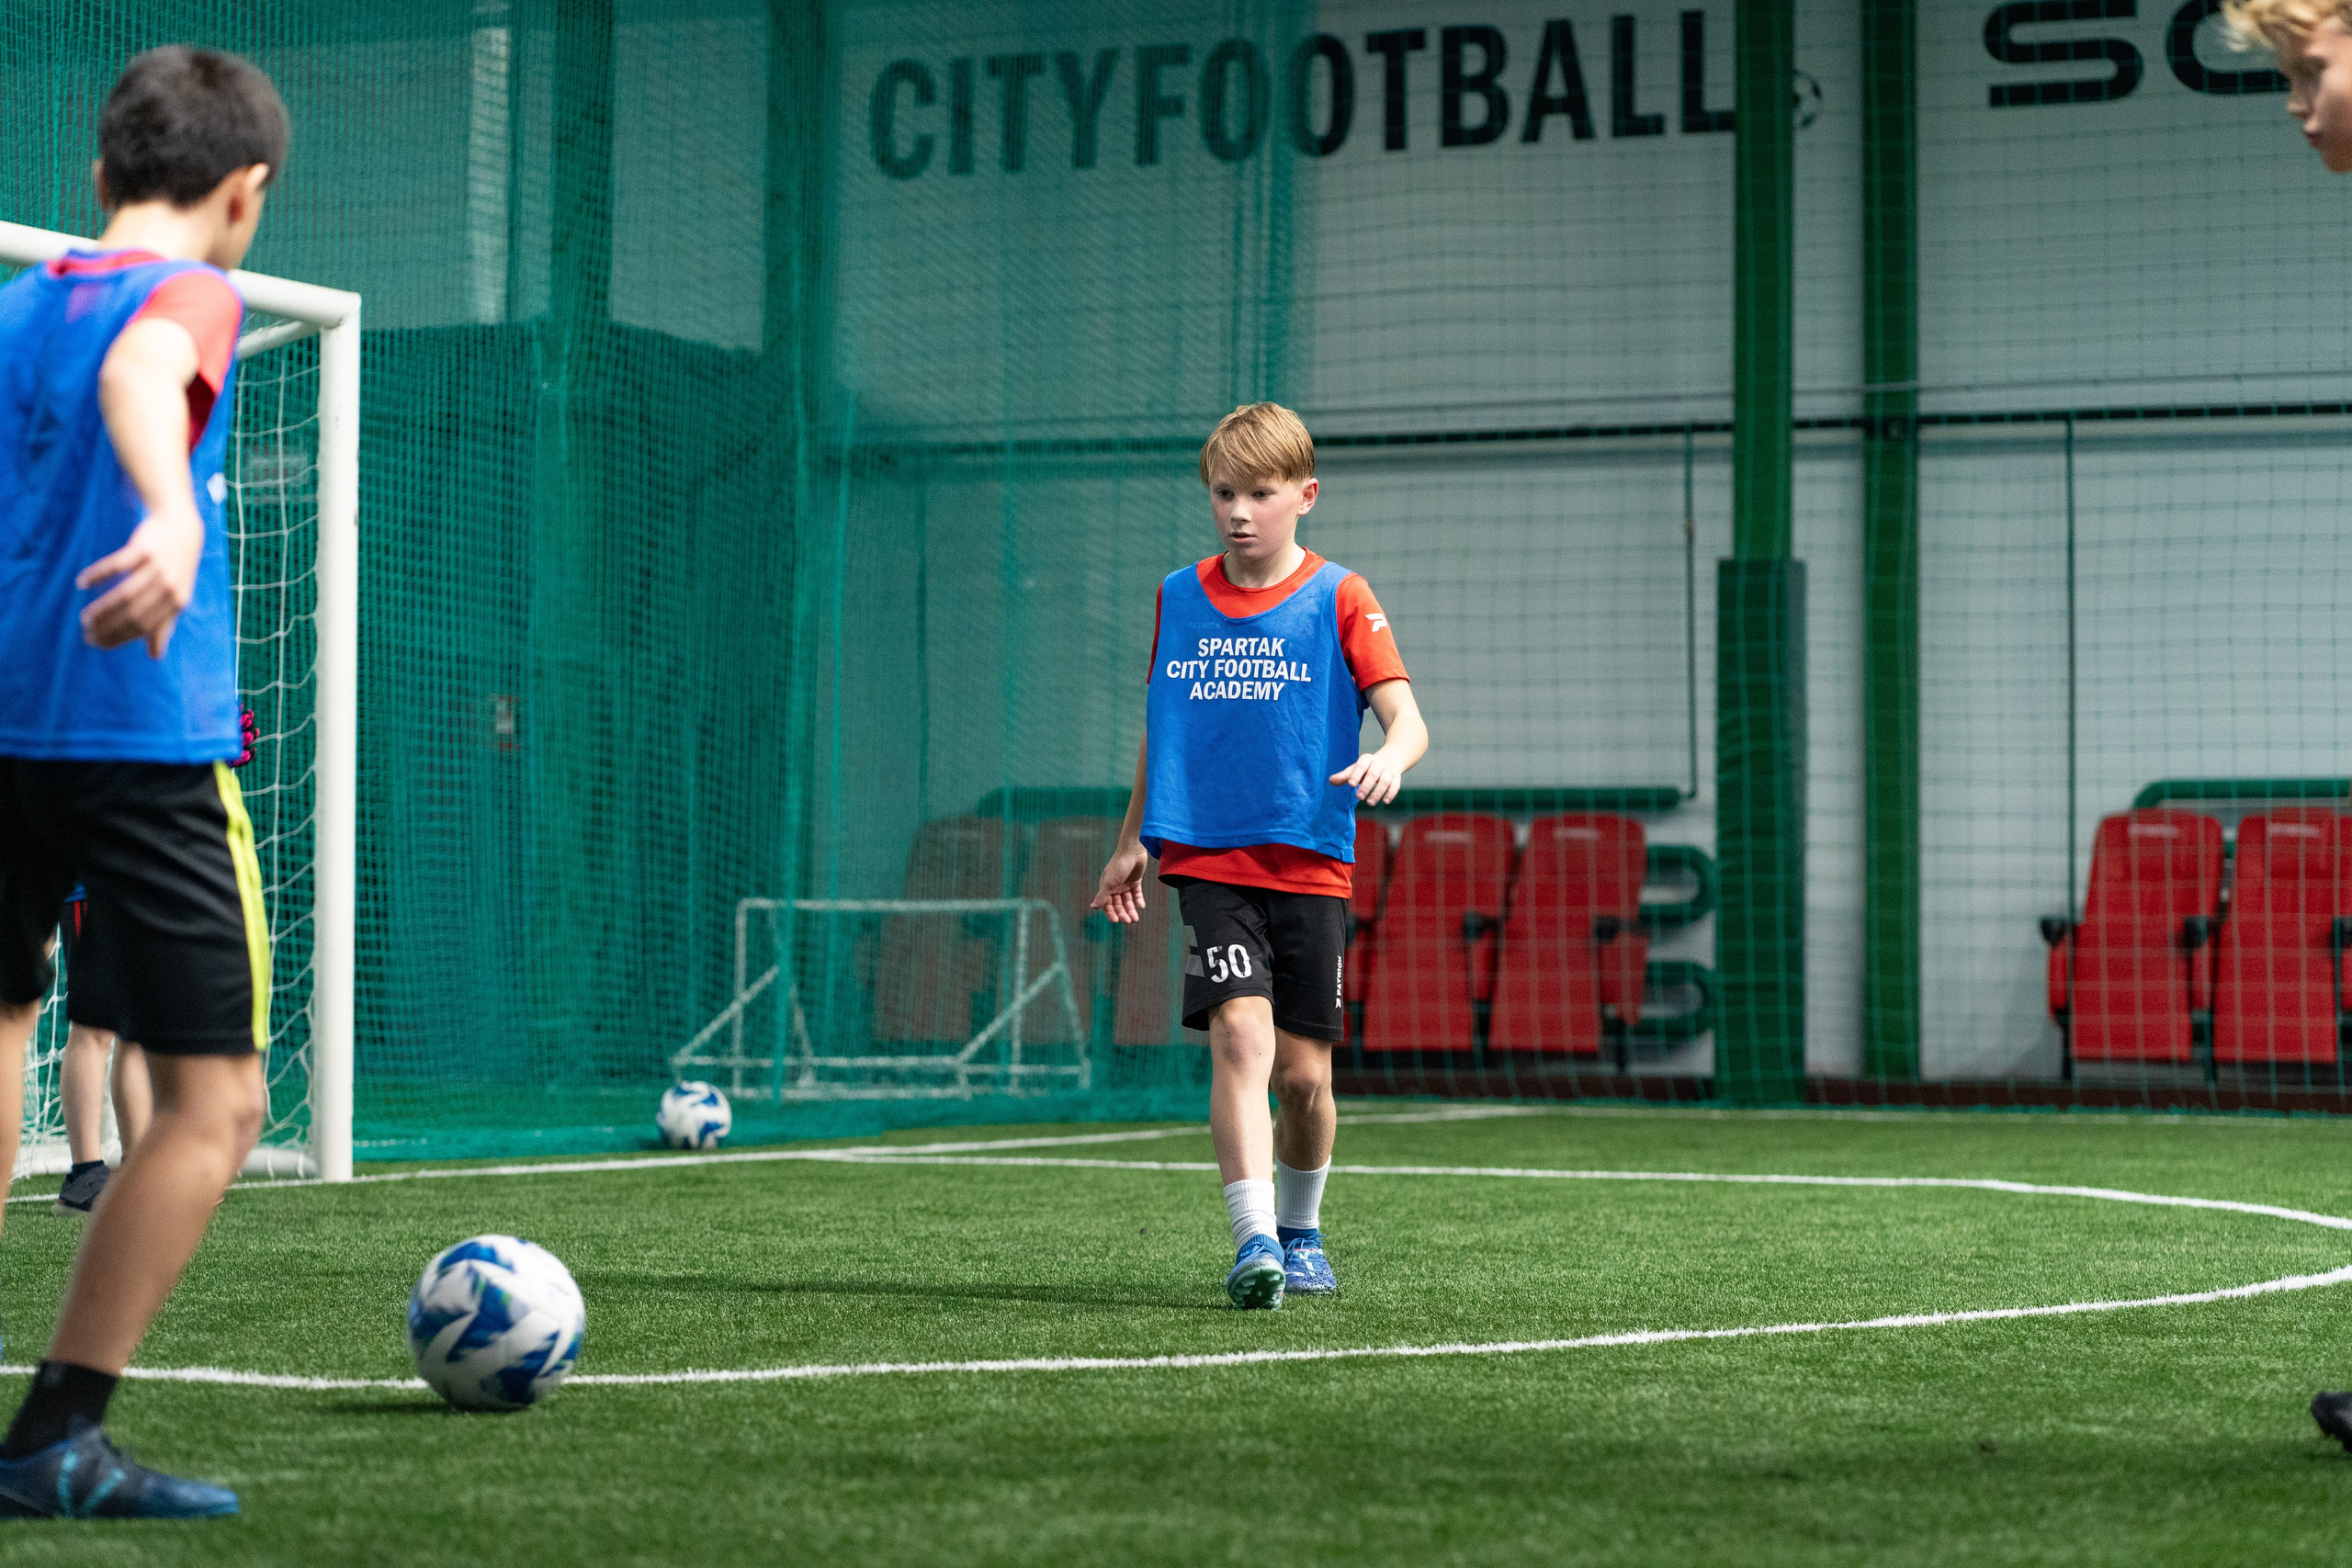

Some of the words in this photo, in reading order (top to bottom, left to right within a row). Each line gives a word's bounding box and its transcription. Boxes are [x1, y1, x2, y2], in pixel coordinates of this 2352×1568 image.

[1198, 637, 1285, 657] SPARTAK
[1166, 660, 1210, 679] CITY
[1215, 659, 1312, 682] FOOTBALL
[1189, 681, 1285, 701] ACADEMY
[1207, 944, 1252, 983] 50
